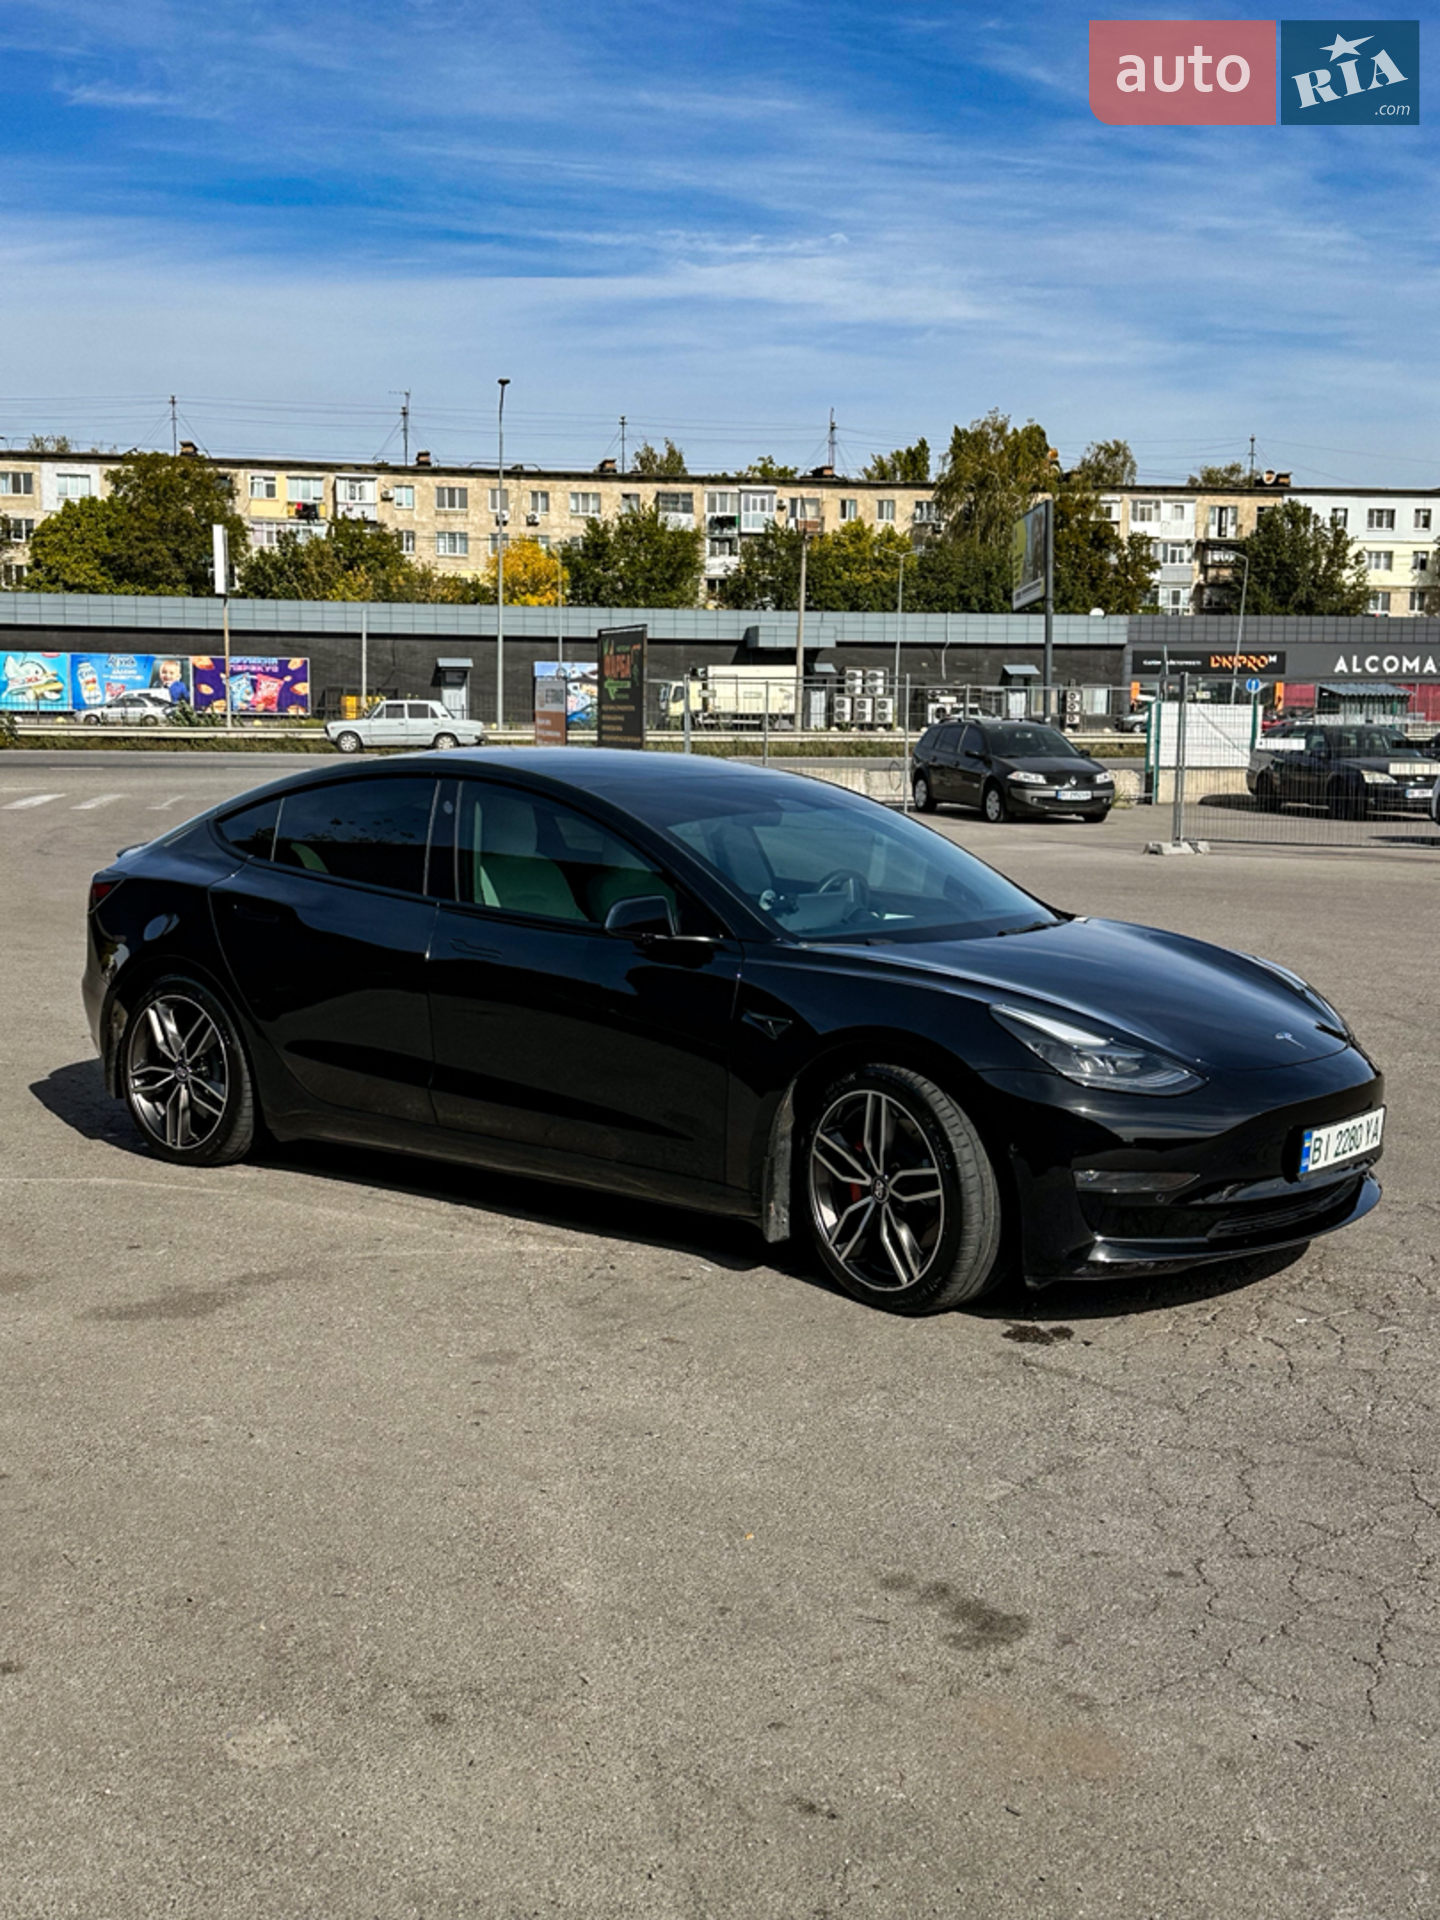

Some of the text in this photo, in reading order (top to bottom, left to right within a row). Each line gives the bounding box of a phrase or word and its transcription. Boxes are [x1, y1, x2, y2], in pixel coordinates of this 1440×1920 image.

[1333, 654, 1438, 675] ALCOMA
[1311, 1116, 1380, 1164] BI 2280 YA
